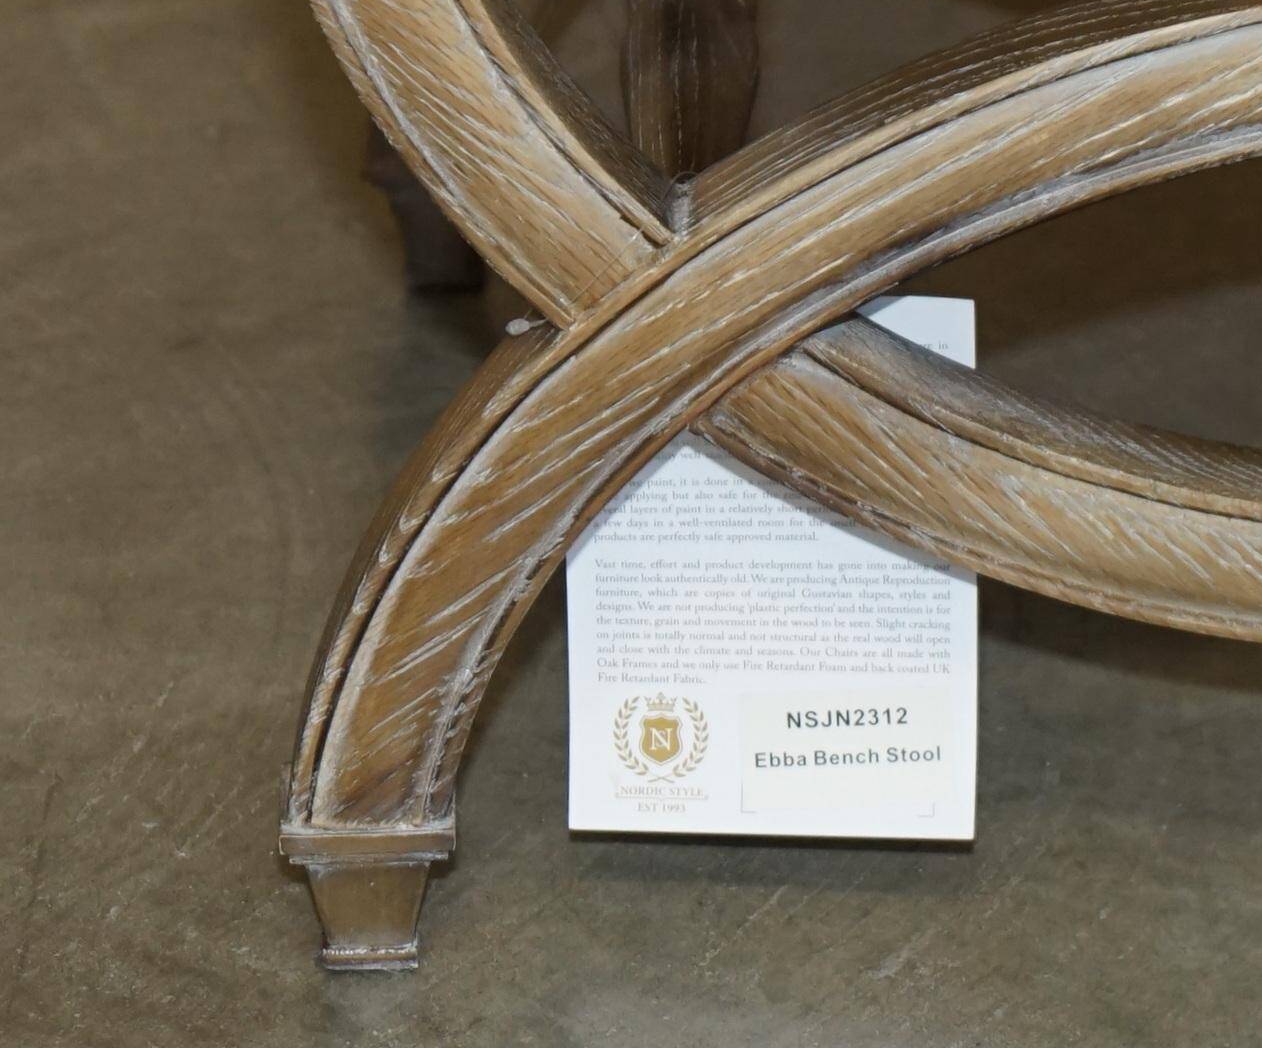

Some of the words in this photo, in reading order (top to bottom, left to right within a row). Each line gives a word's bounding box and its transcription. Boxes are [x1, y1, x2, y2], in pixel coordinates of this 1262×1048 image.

[593, 533, 637, 544] products
[726, 532, 772, 544] approved
[787, 707, 909, 729] NSJN2312
[754, 752, 807, 769] Ebba
[814, 748, 880, 766] Bench
[886, 746, 942, 763] Stool
[619, 786, 666, 796] NORDIC
[669, 787, 705, 797] STYLE
[637, 802, 658, 813] EST
